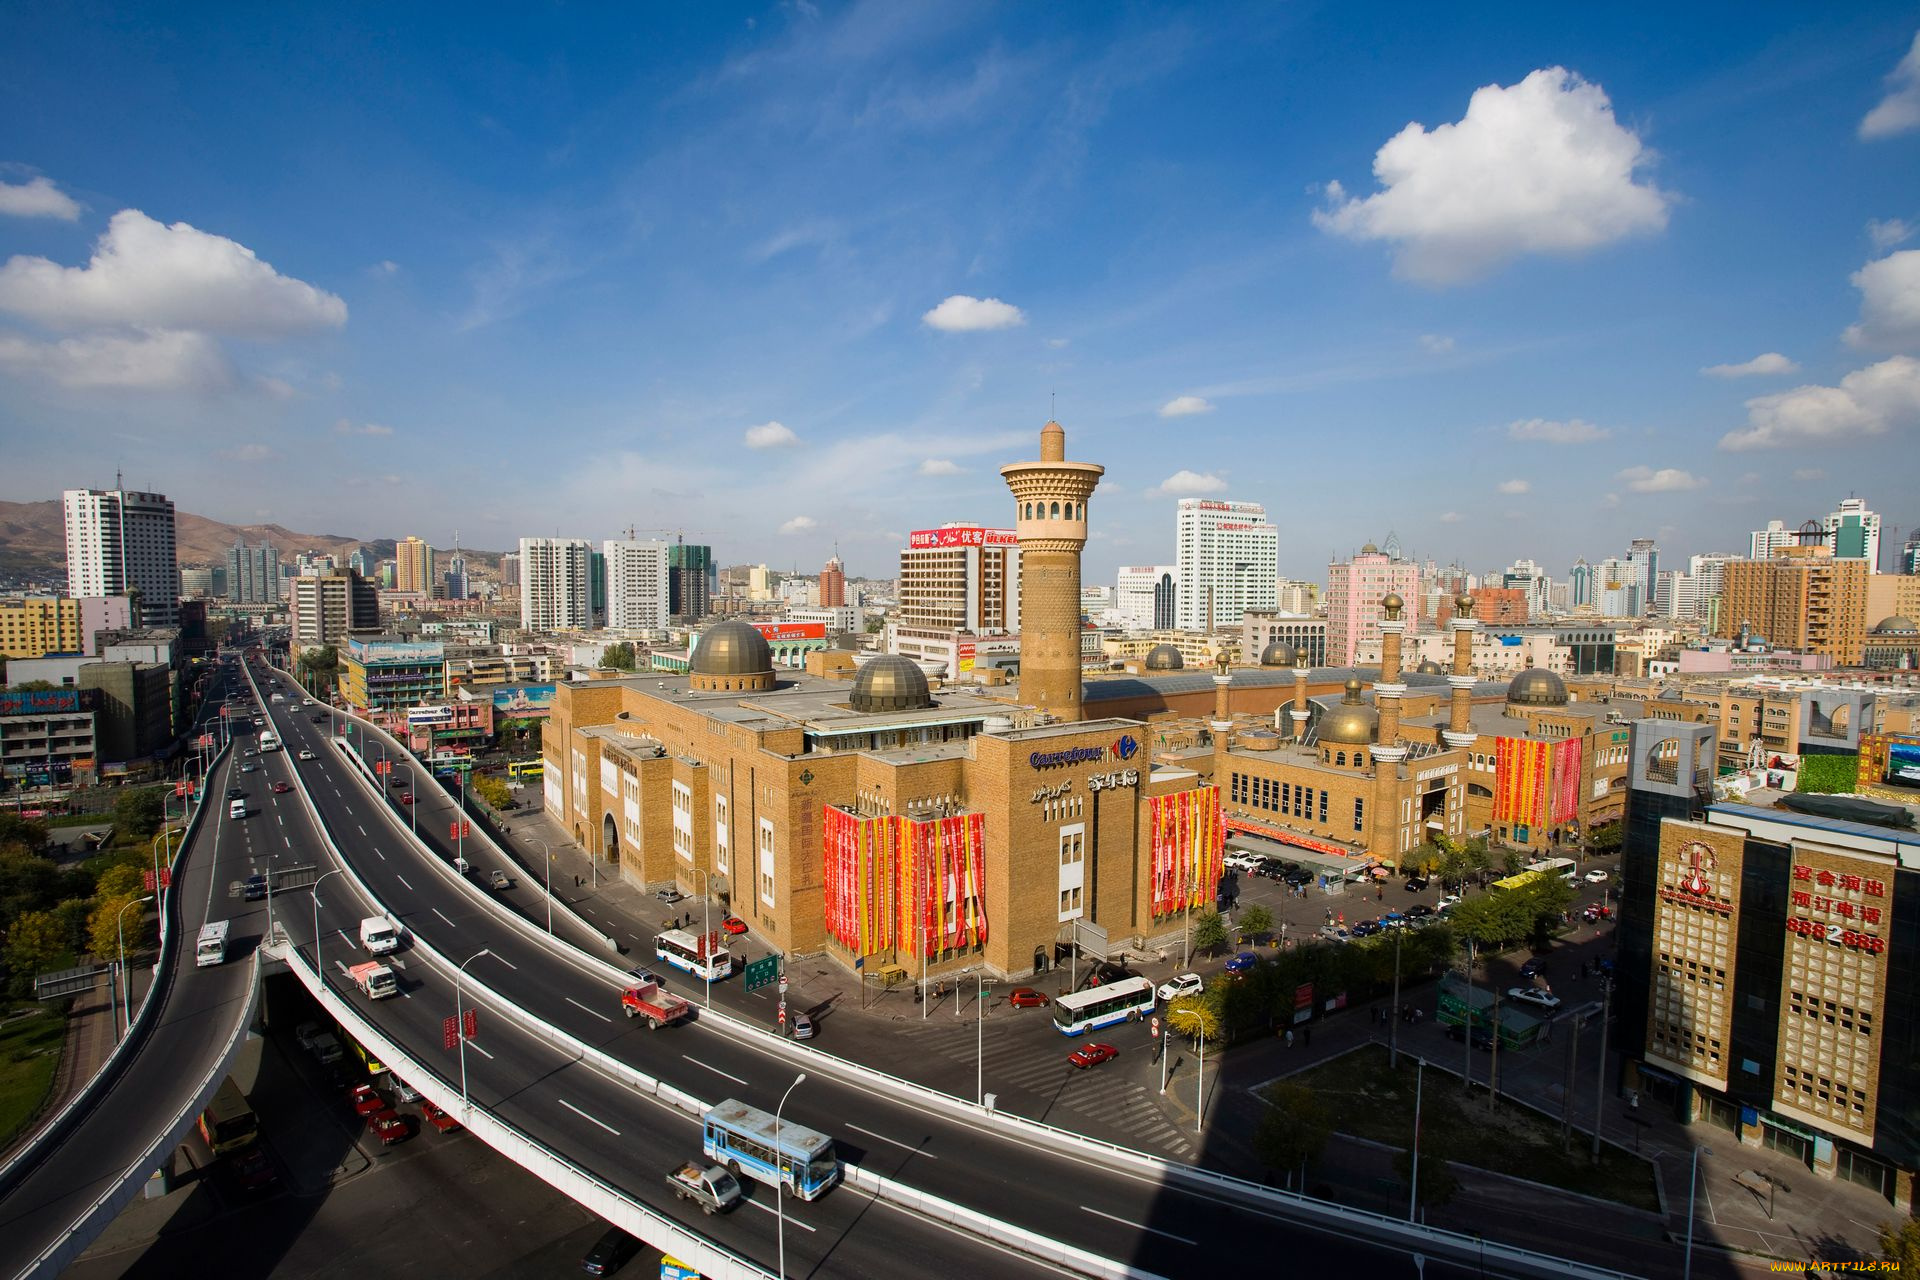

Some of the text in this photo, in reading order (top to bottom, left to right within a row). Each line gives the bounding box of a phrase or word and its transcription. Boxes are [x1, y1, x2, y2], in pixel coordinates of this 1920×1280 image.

[961, 530, 982, 544] 优客
[1030, 747, 1102, 767] Carrefour
[1793, 865, 1884, 897] 宴会演出
[1792, 890, 1882, 925] 预订电话
[1786, 917, 1885, 953] 8882888
